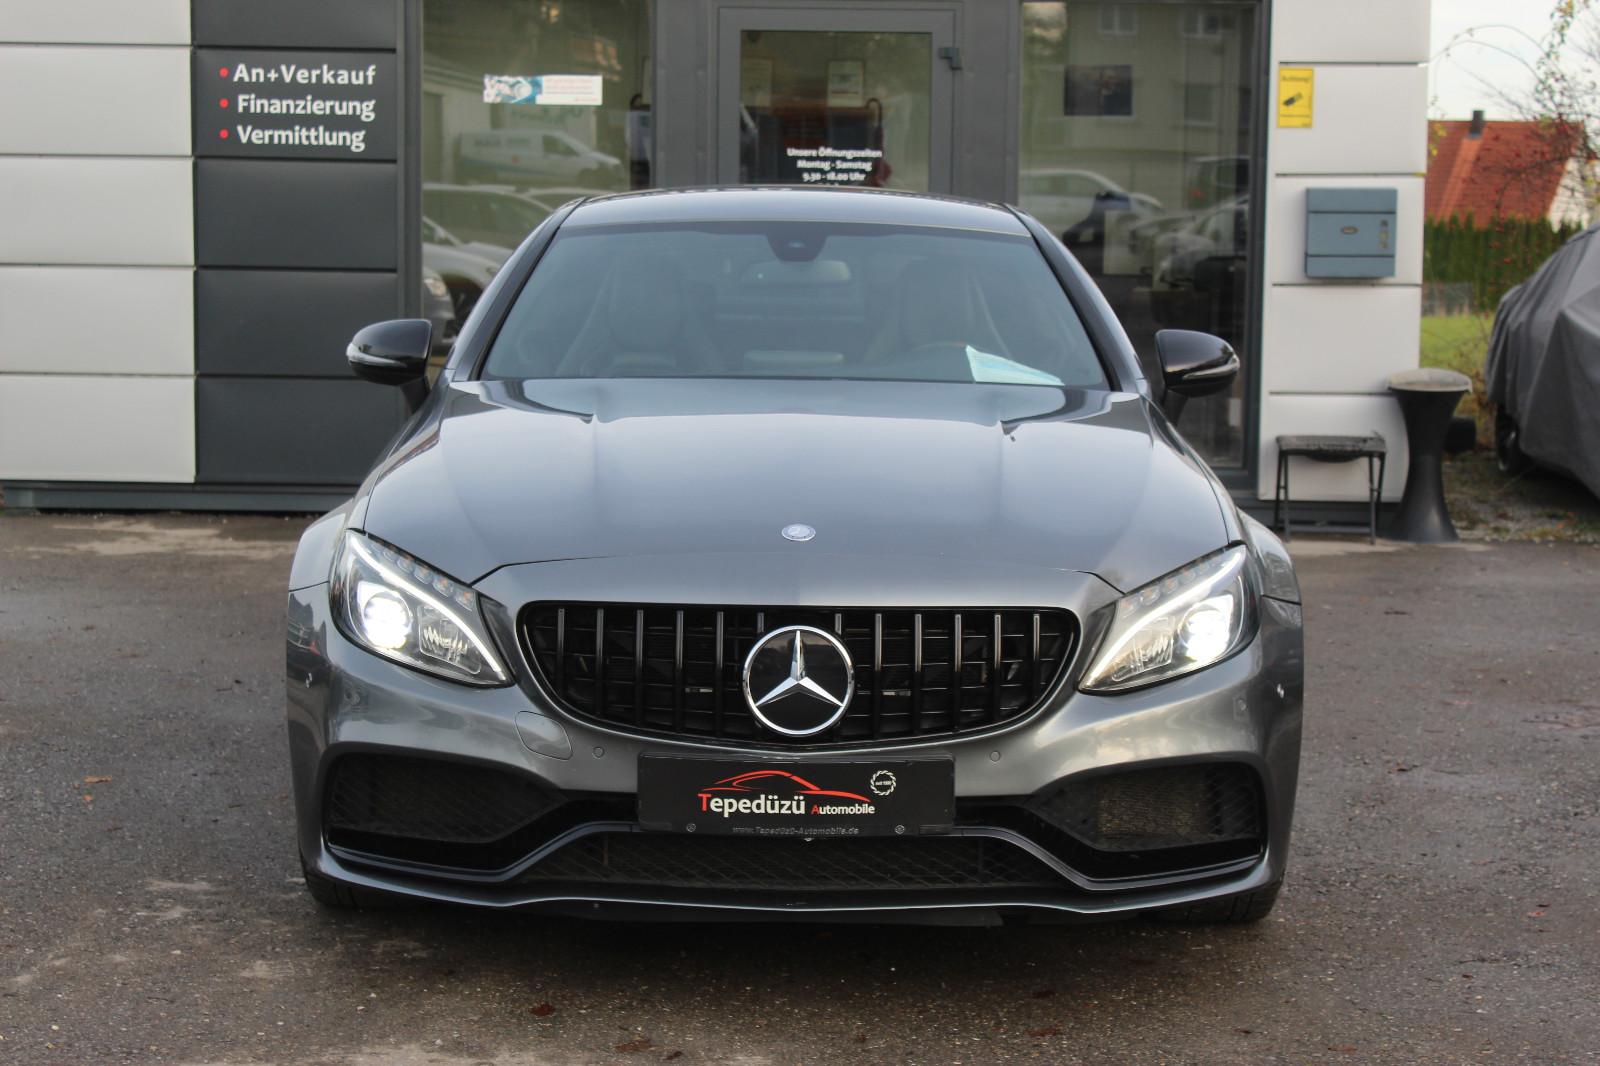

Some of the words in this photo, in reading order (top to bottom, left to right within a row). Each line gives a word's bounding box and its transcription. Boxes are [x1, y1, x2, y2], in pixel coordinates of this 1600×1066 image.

[233, 63, 376, 85] An+Verkauf
[237, 93, 376, 122] Finanzierung
[236, 124, 366, 152] Vermittlung
[698, 794, 805, 818] Tepedüzü
[811, 804, 876, 815] Automobile
